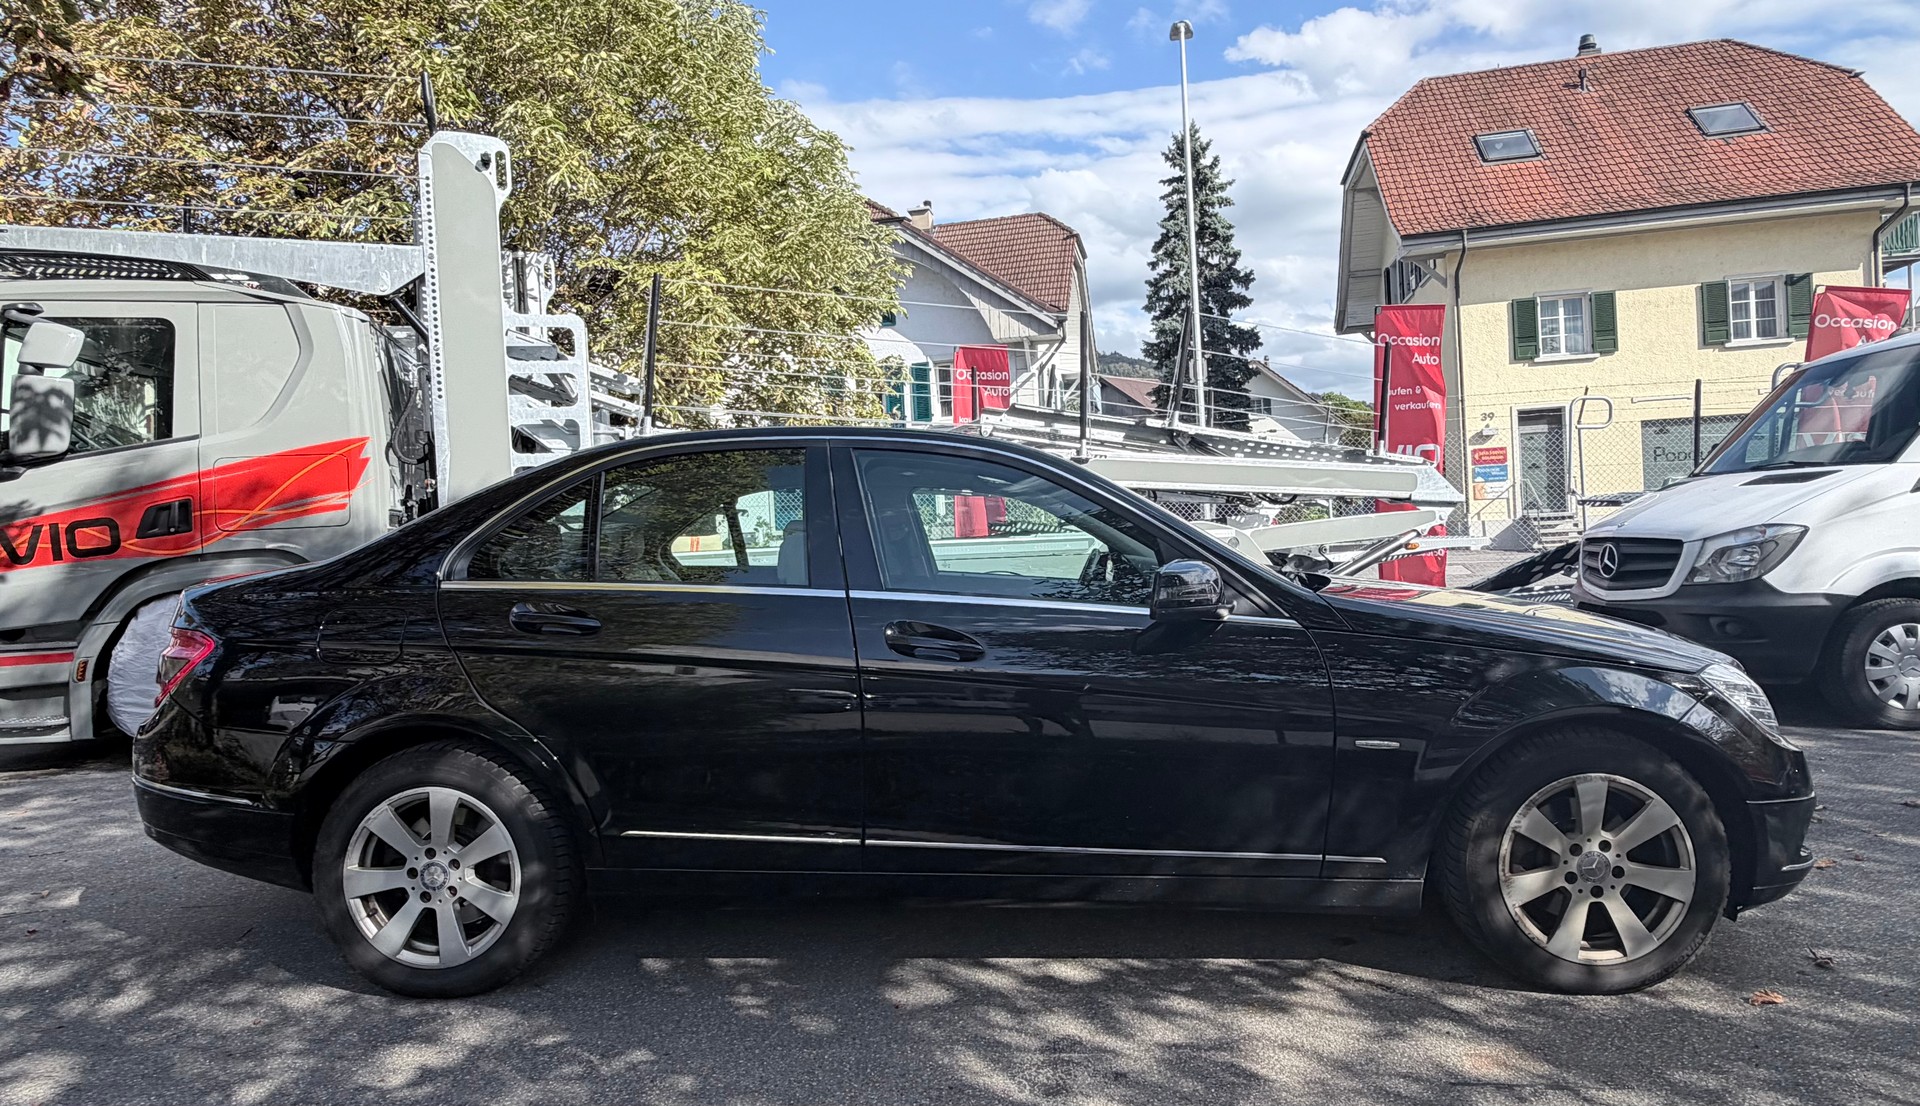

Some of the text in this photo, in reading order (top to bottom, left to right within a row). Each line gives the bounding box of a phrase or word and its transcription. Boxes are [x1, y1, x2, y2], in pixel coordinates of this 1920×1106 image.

[1814, 313, 1898, 331] Occasion
[1378, 333, 1441, 347] Occasion
[1412, 352, 1440, 366] Auto
[984, 386, 1009, 397] Auto
[1415, 385, 1422, 394] &
[1394, 400, 1442, 411] verkaufen
[1480, 411, 1495, 422] 39
